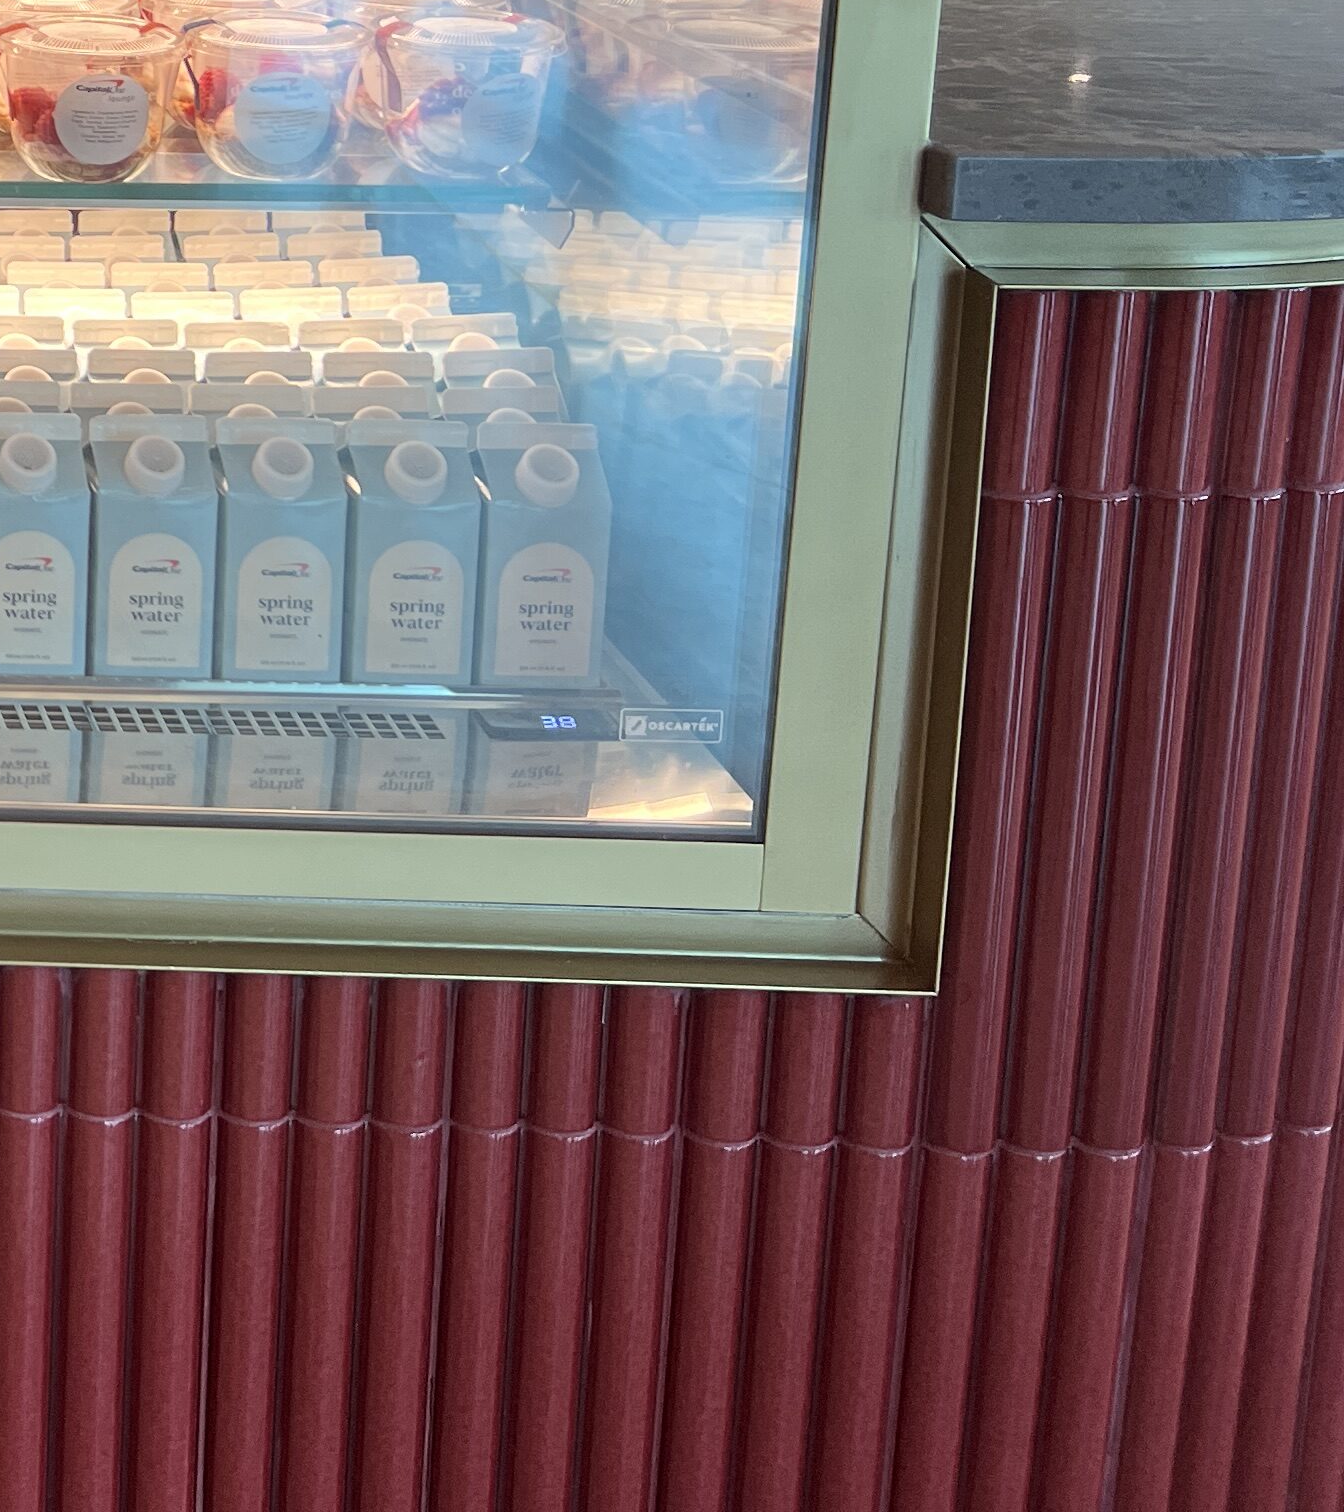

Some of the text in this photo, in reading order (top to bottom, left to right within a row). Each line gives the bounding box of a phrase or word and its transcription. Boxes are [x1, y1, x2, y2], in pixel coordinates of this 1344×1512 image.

[128, 591, 184, 610] spring
[131, 608, 183, 623] water
[519, 600, 574, 620] spring
[521, 617, 572, 632] water
[541, 715, 577, 729] 38
